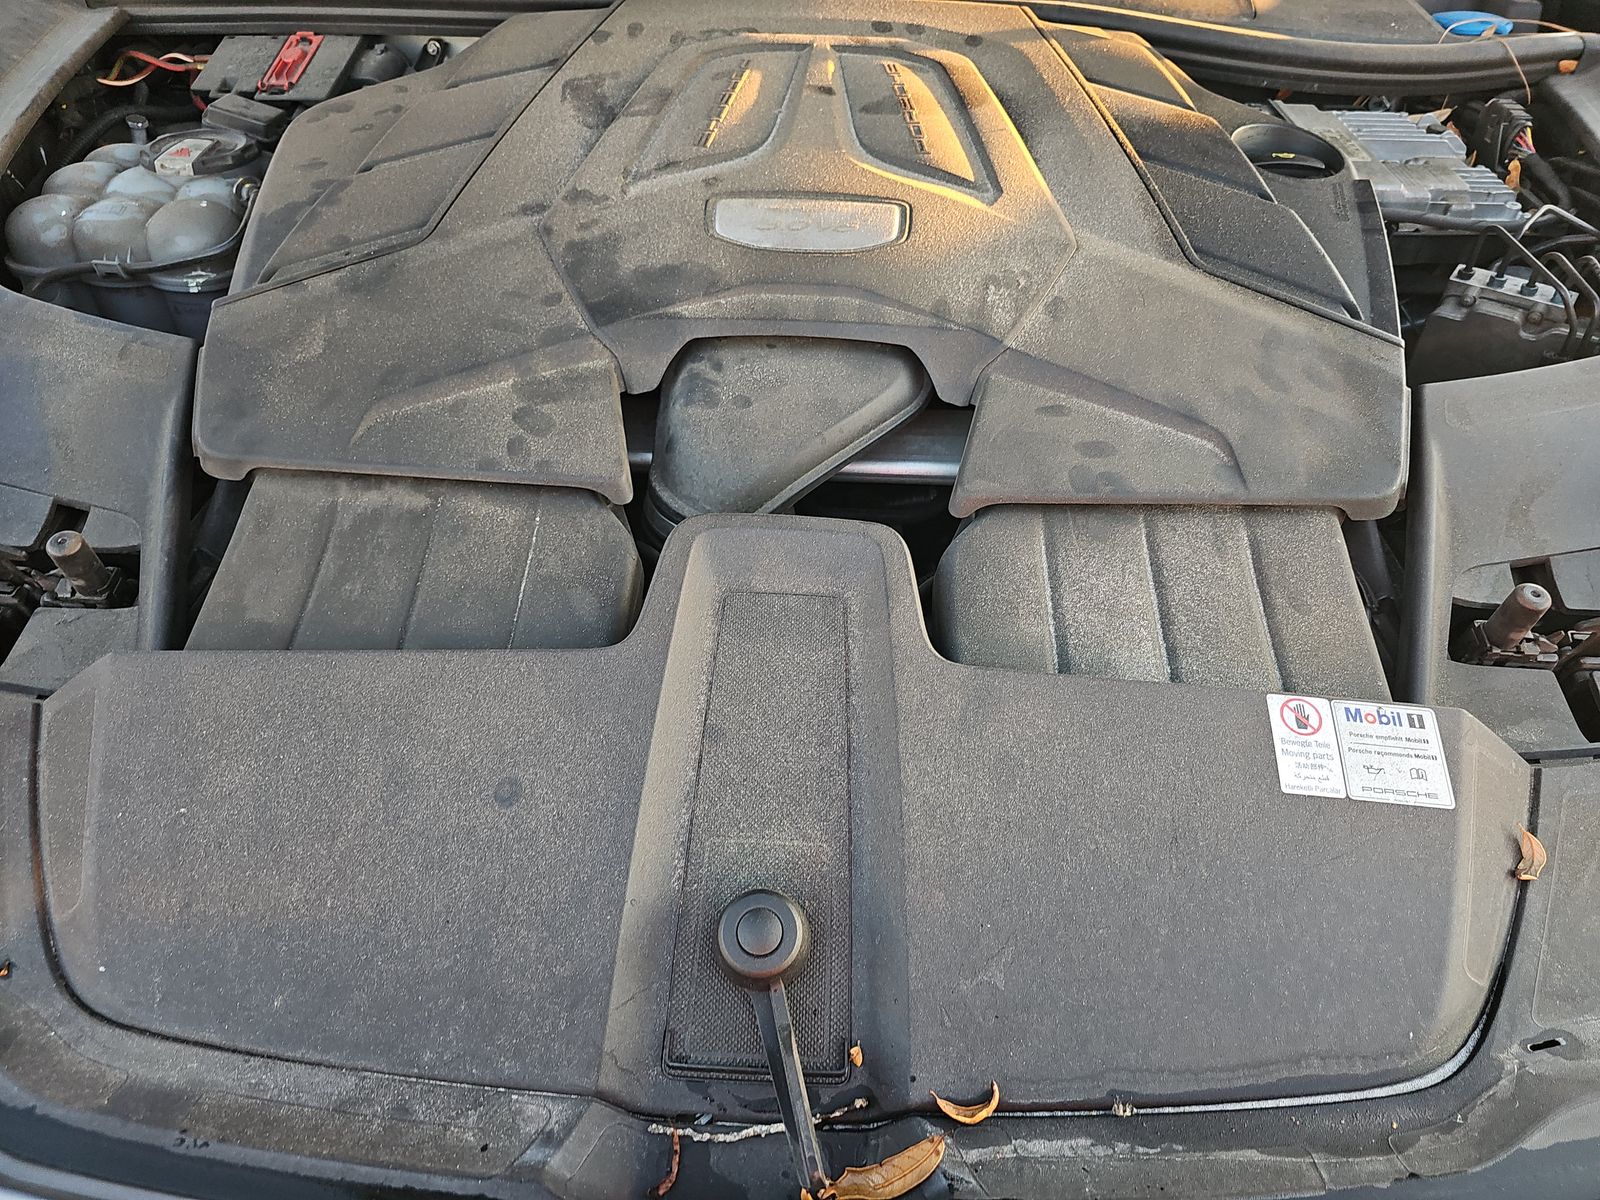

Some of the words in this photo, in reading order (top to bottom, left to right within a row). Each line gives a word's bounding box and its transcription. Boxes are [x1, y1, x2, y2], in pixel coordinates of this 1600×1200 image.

[1344, 706, 1403, 727] Mobil
[1349, 731, 1374, 739] Porsche
[1281, 748, 1311, 761] Moving
[1313, 752, 1335, 761] parts
[1348, 747, 1373, 755] Porsche
[1361, 786, 1439, 799] PORSCHE
